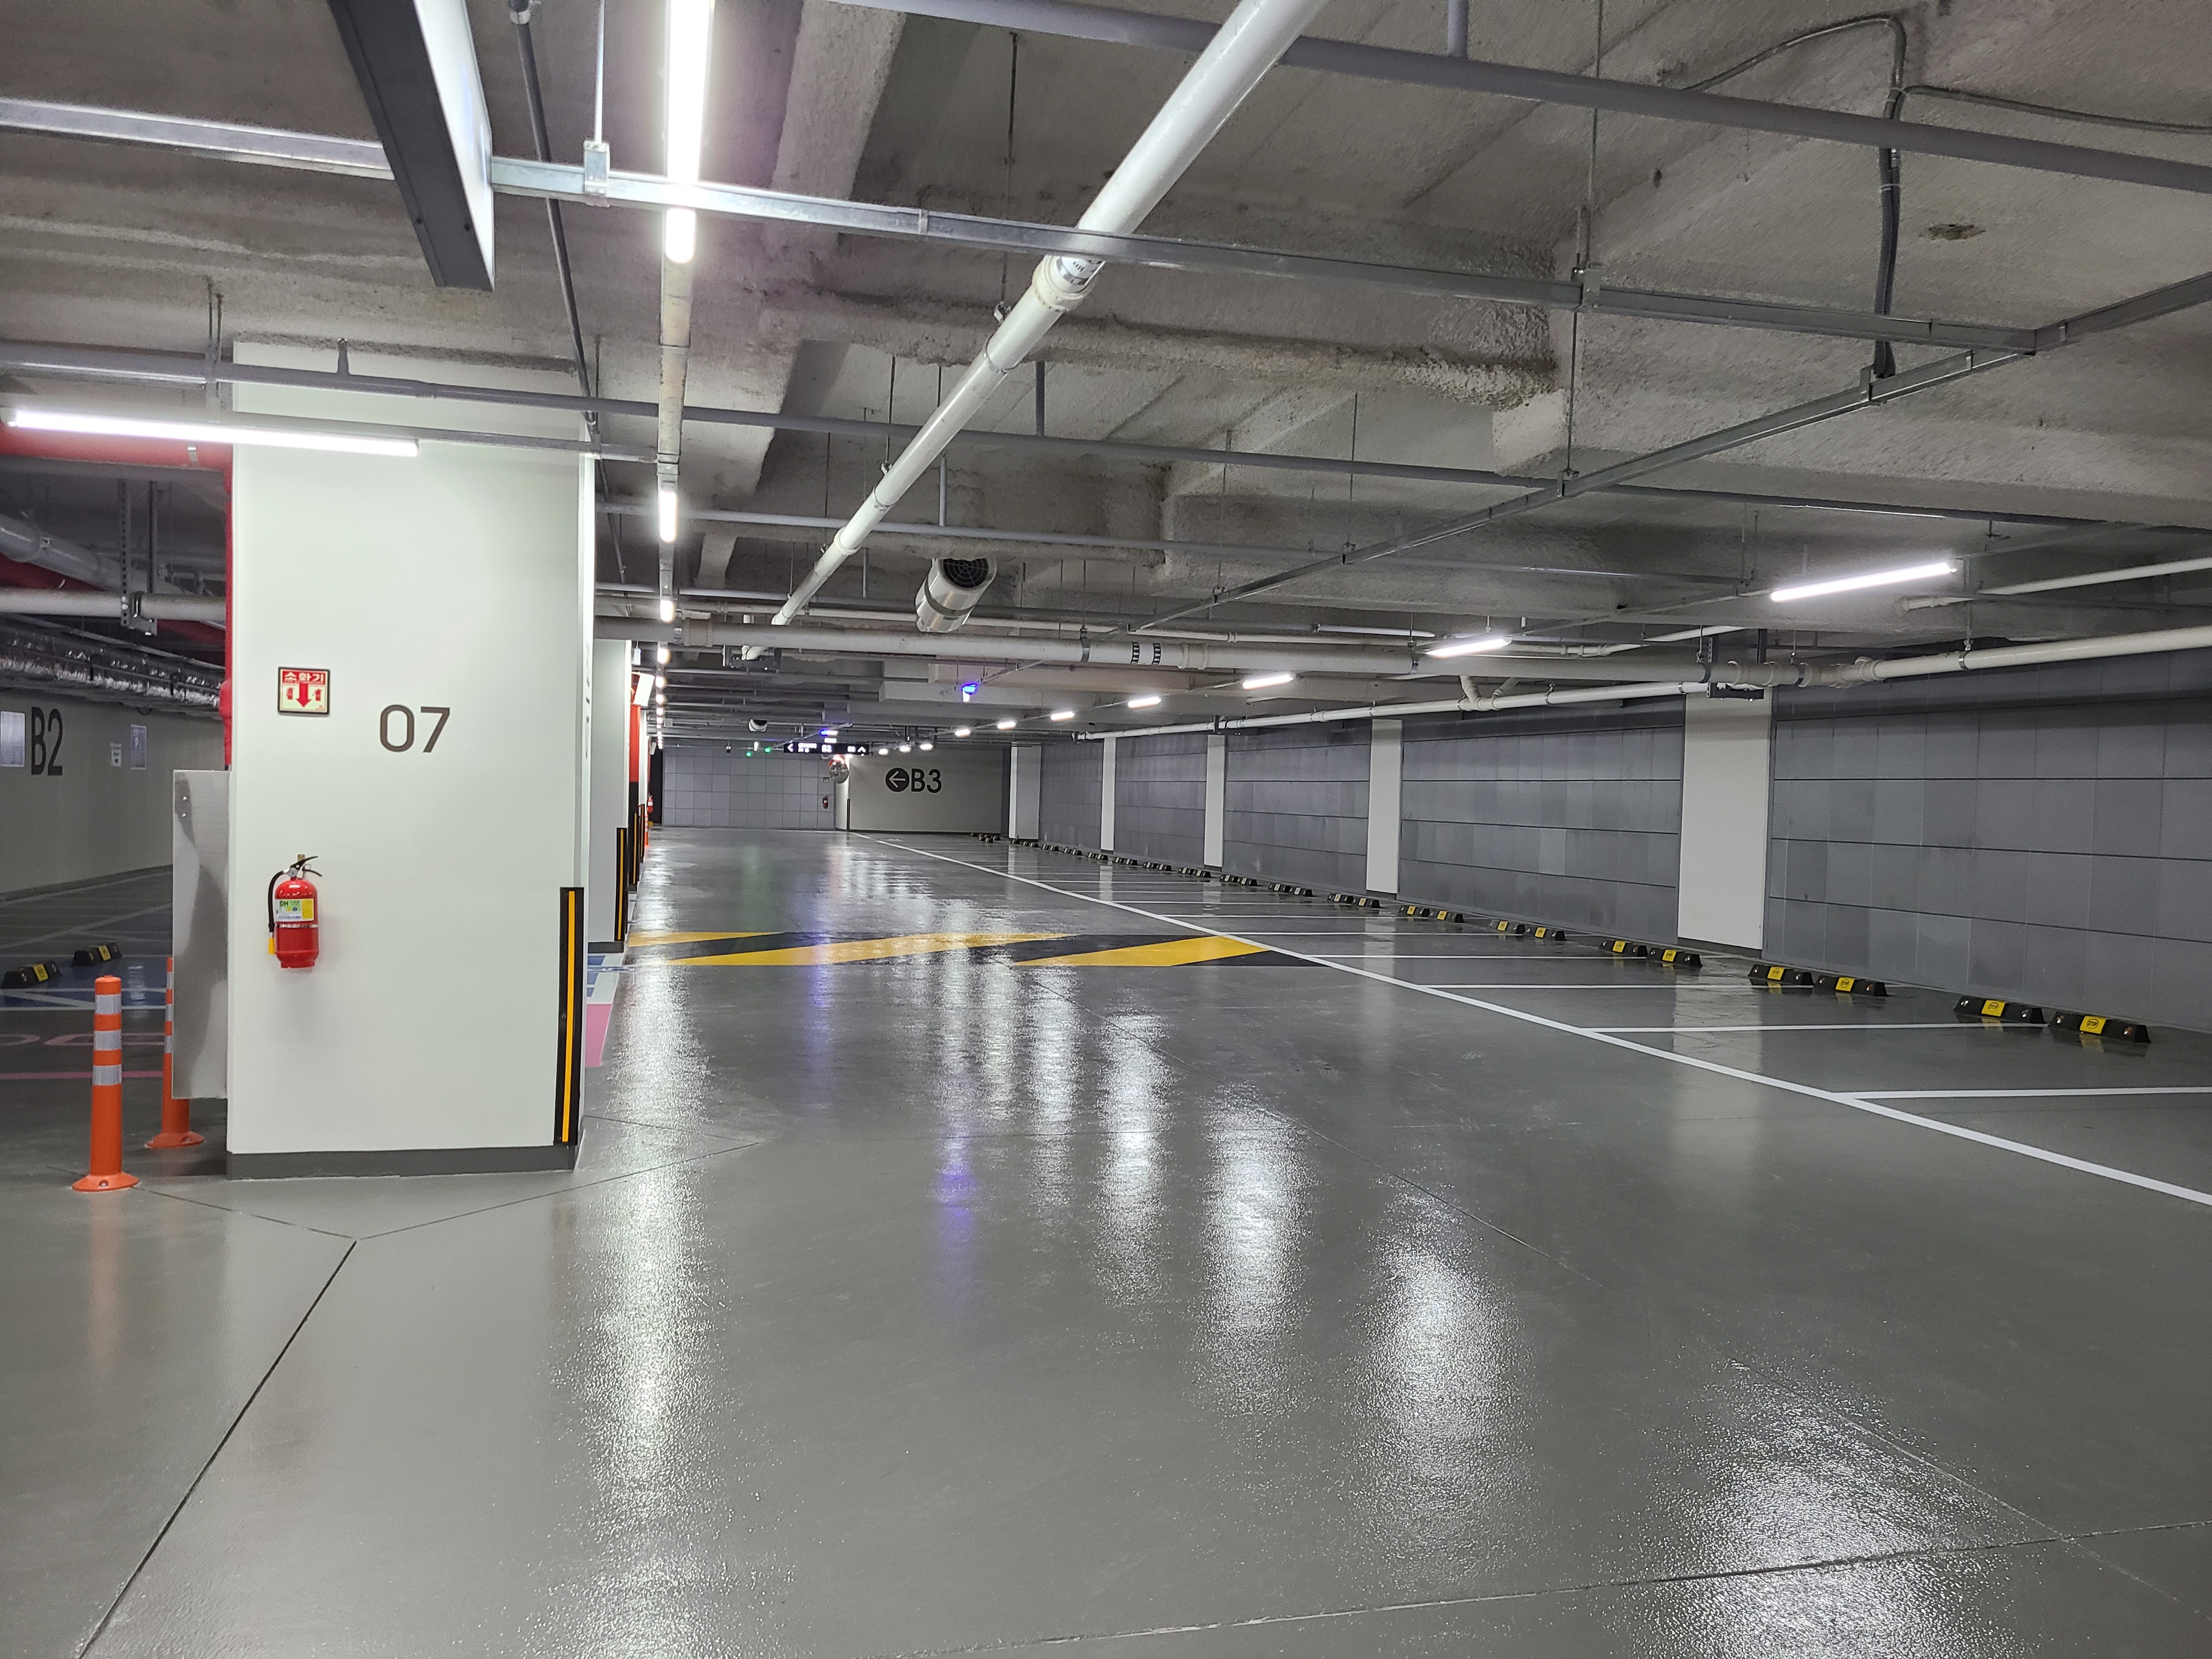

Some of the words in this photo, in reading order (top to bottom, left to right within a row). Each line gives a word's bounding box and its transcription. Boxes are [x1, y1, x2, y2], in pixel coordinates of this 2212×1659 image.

[284, 672, 324, 682] 소화기
[31, 706, 63, 776] B2
[380, 704, 450, 753] 07
[911, 768, 942, 793] B3
